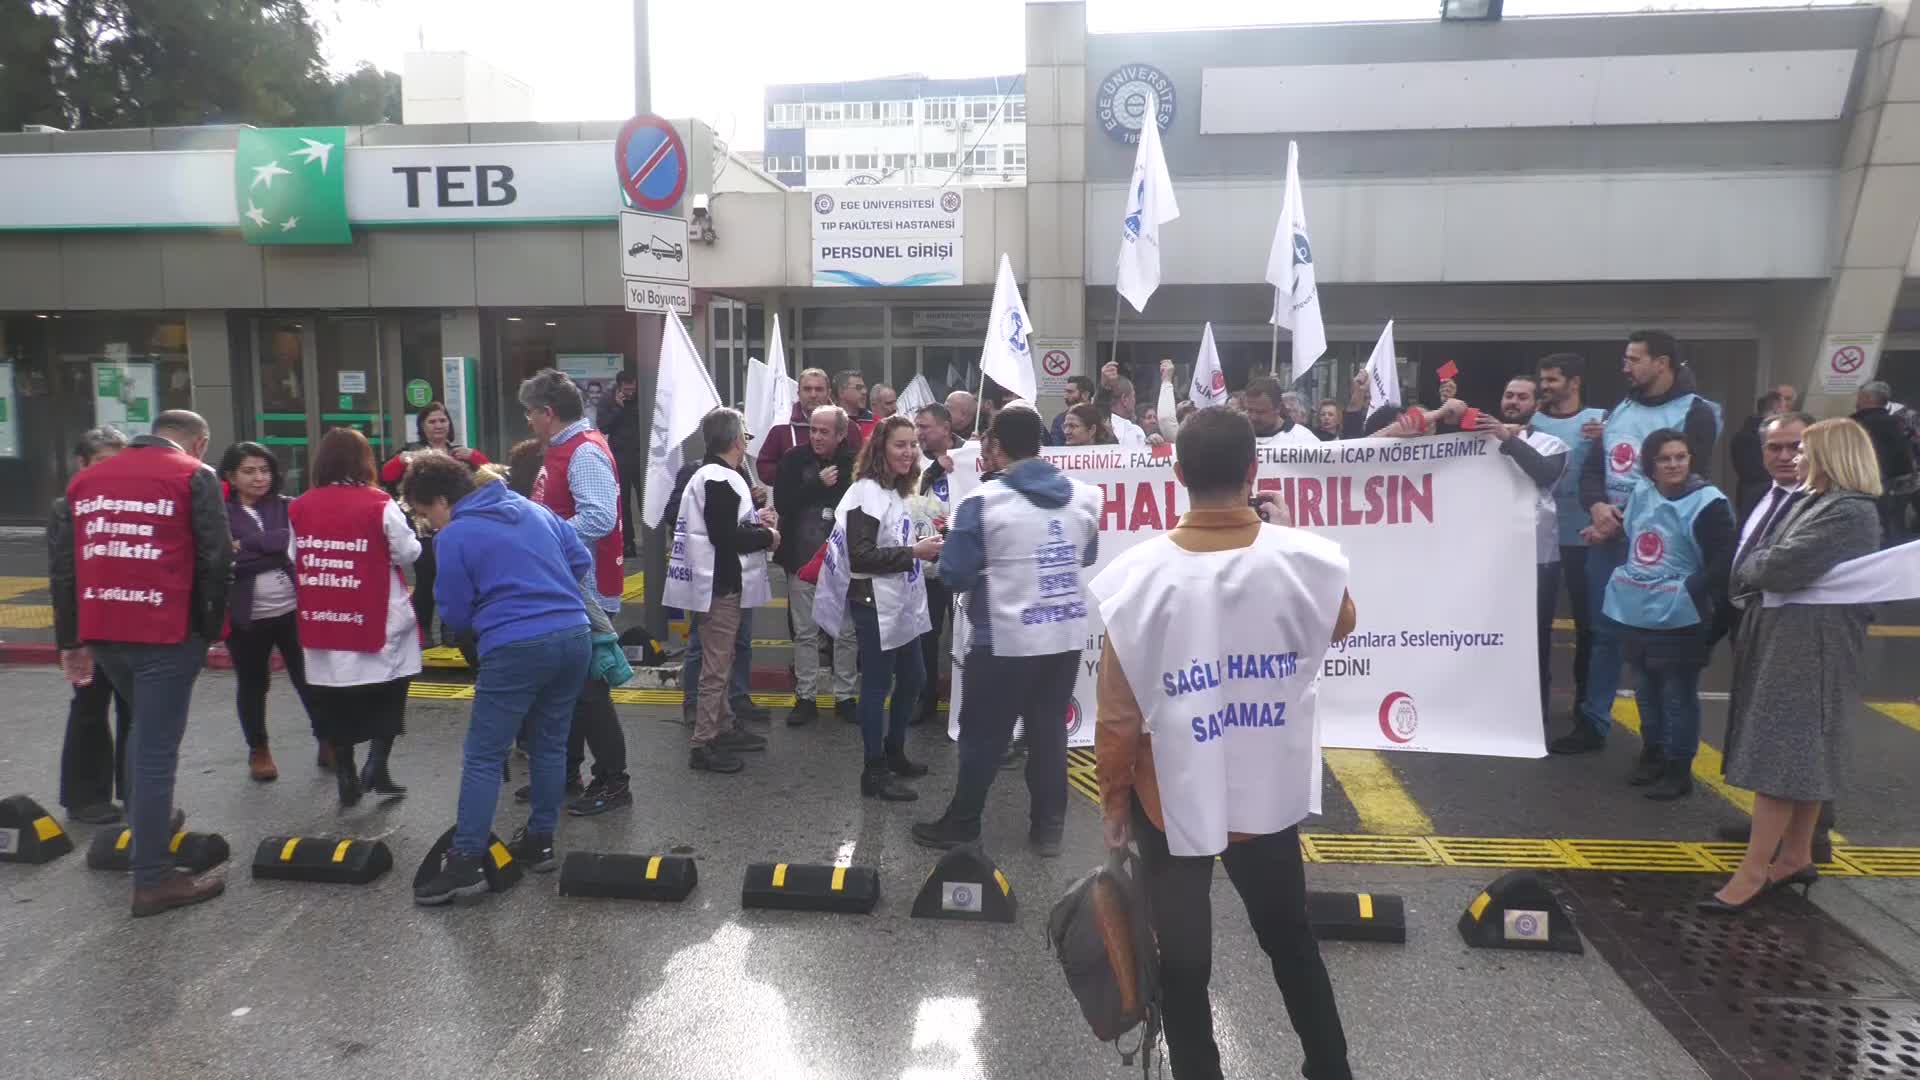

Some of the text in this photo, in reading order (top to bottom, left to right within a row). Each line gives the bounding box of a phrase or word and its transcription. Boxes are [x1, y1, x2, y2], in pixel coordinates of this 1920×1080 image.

[1099, 98, 1118, 131] EGE
[392, 164, 518, 208] TEB
[840, 197, 935, 210] EGE ÜNİVERSİTESİ
[820, 218, 955, 231] TIP FAKÜLTESİ HASTANESİ
[822, 243, 953, 261] PERSONEL GİRİŞİ
[631, 287, 687, 309] Yol Boyunca
[1340, 443, 1374, 464] İCAP
[1379, 438, 1487, 463] NÖBETLERİMİZ
[1098, 480, 1182, 531] HAL
[1401, 630, 1505, 652] Sesleniyoruz:
[1162, 651, 1299, 697] SAĞLI HAKTIR
[1324, 656, 1371, 677] EDİN!
